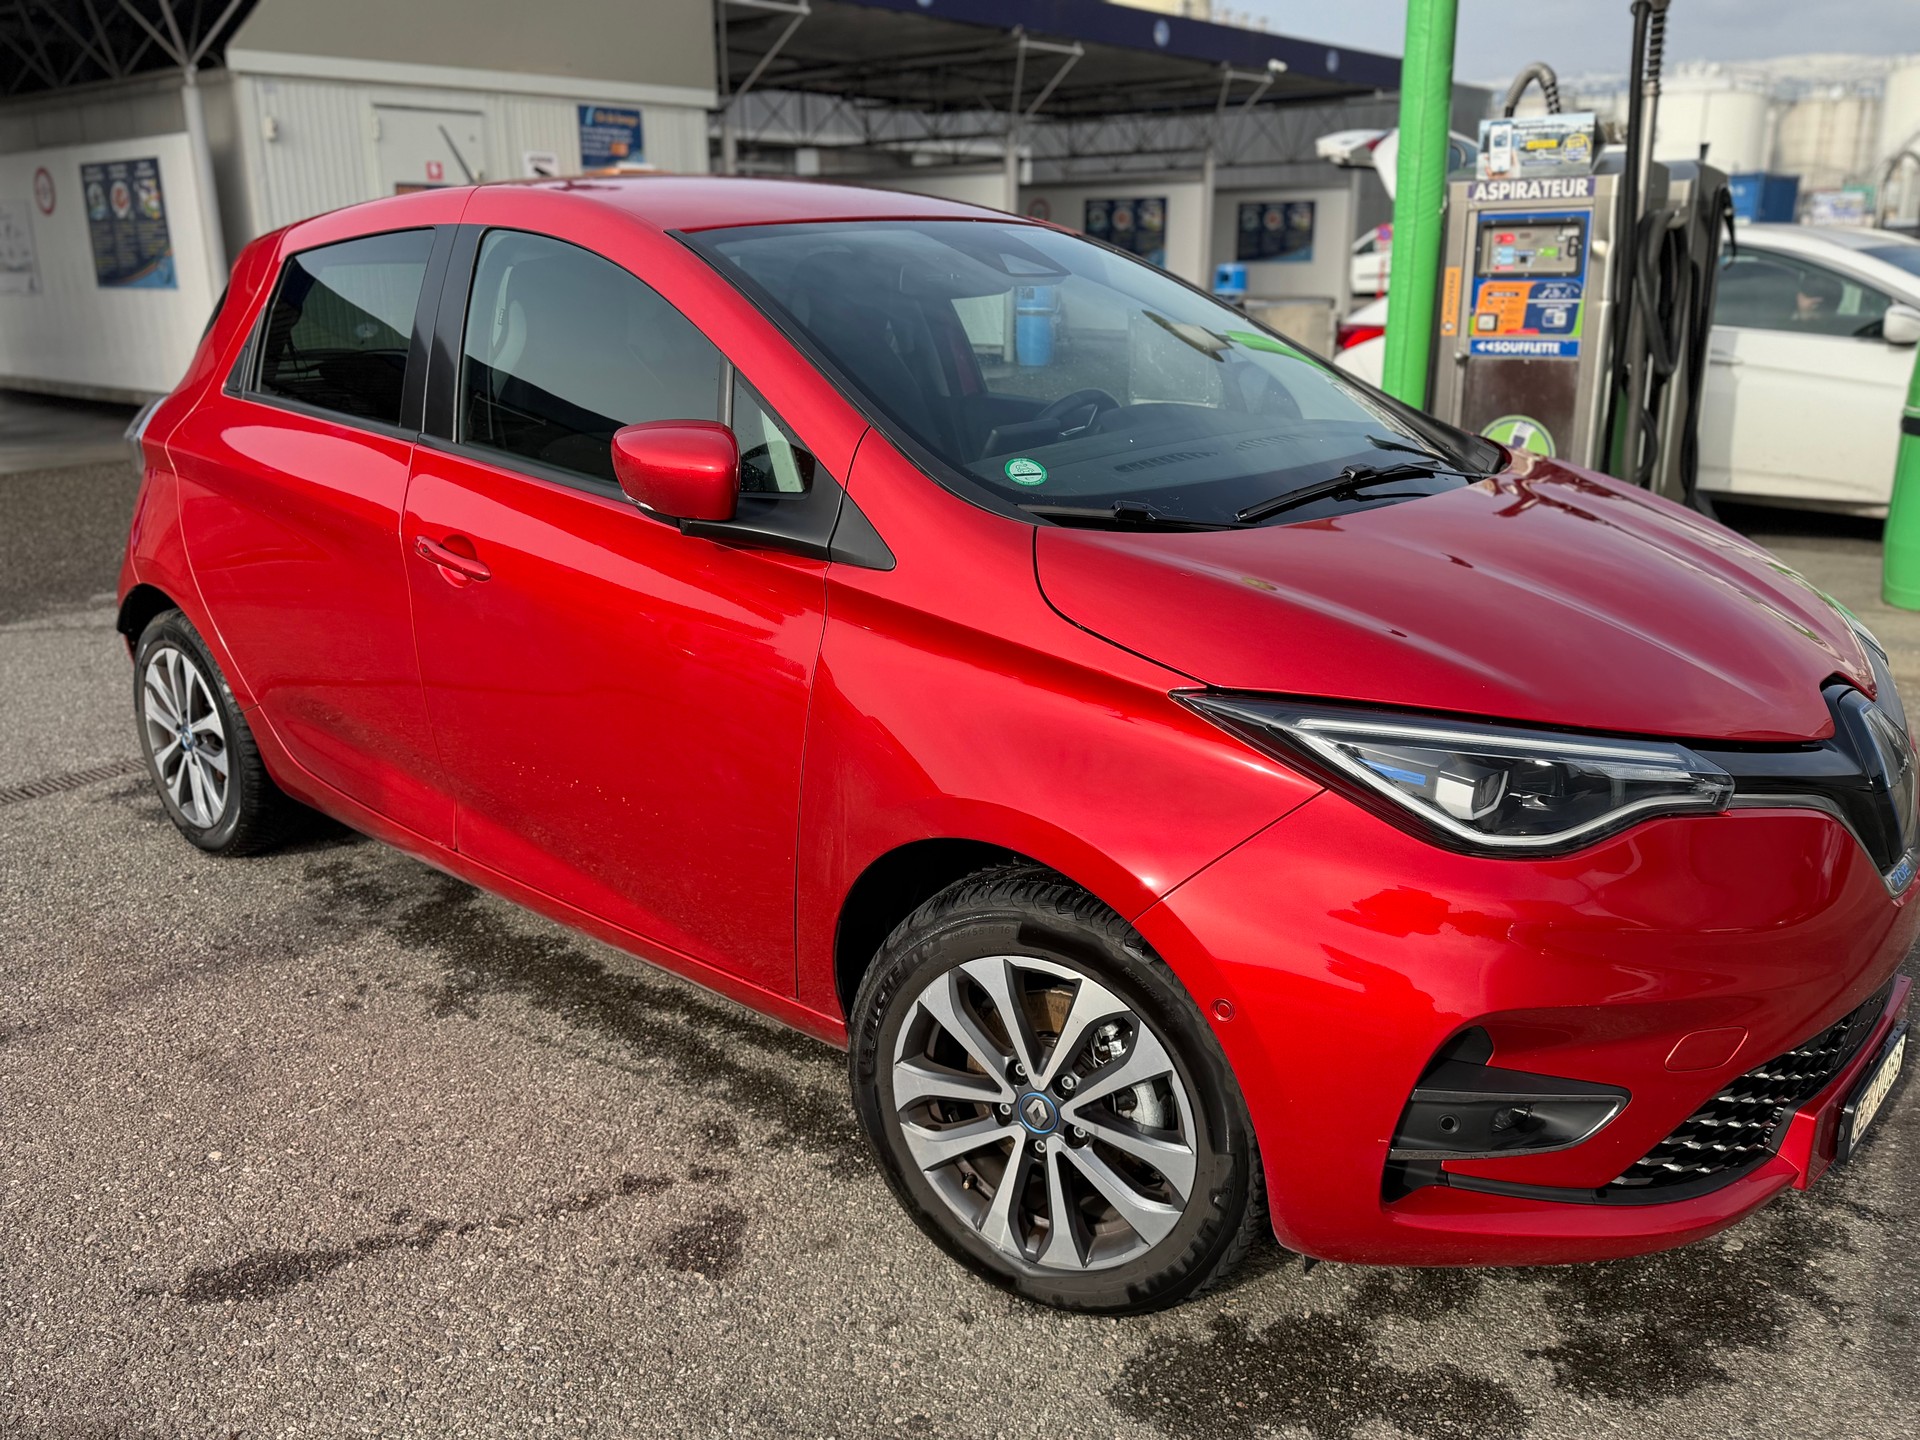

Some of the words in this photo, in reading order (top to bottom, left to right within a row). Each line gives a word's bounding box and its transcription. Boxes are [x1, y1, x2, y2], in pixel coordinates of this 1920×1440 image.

[1474, 178, 1589, 201] ASPIRATEUR
[1494, 341, 1560, 354] SOUFFLETTE
[1891, 862, 1912, 887] ZOE
[1000, 925, 1011, 935] 16
